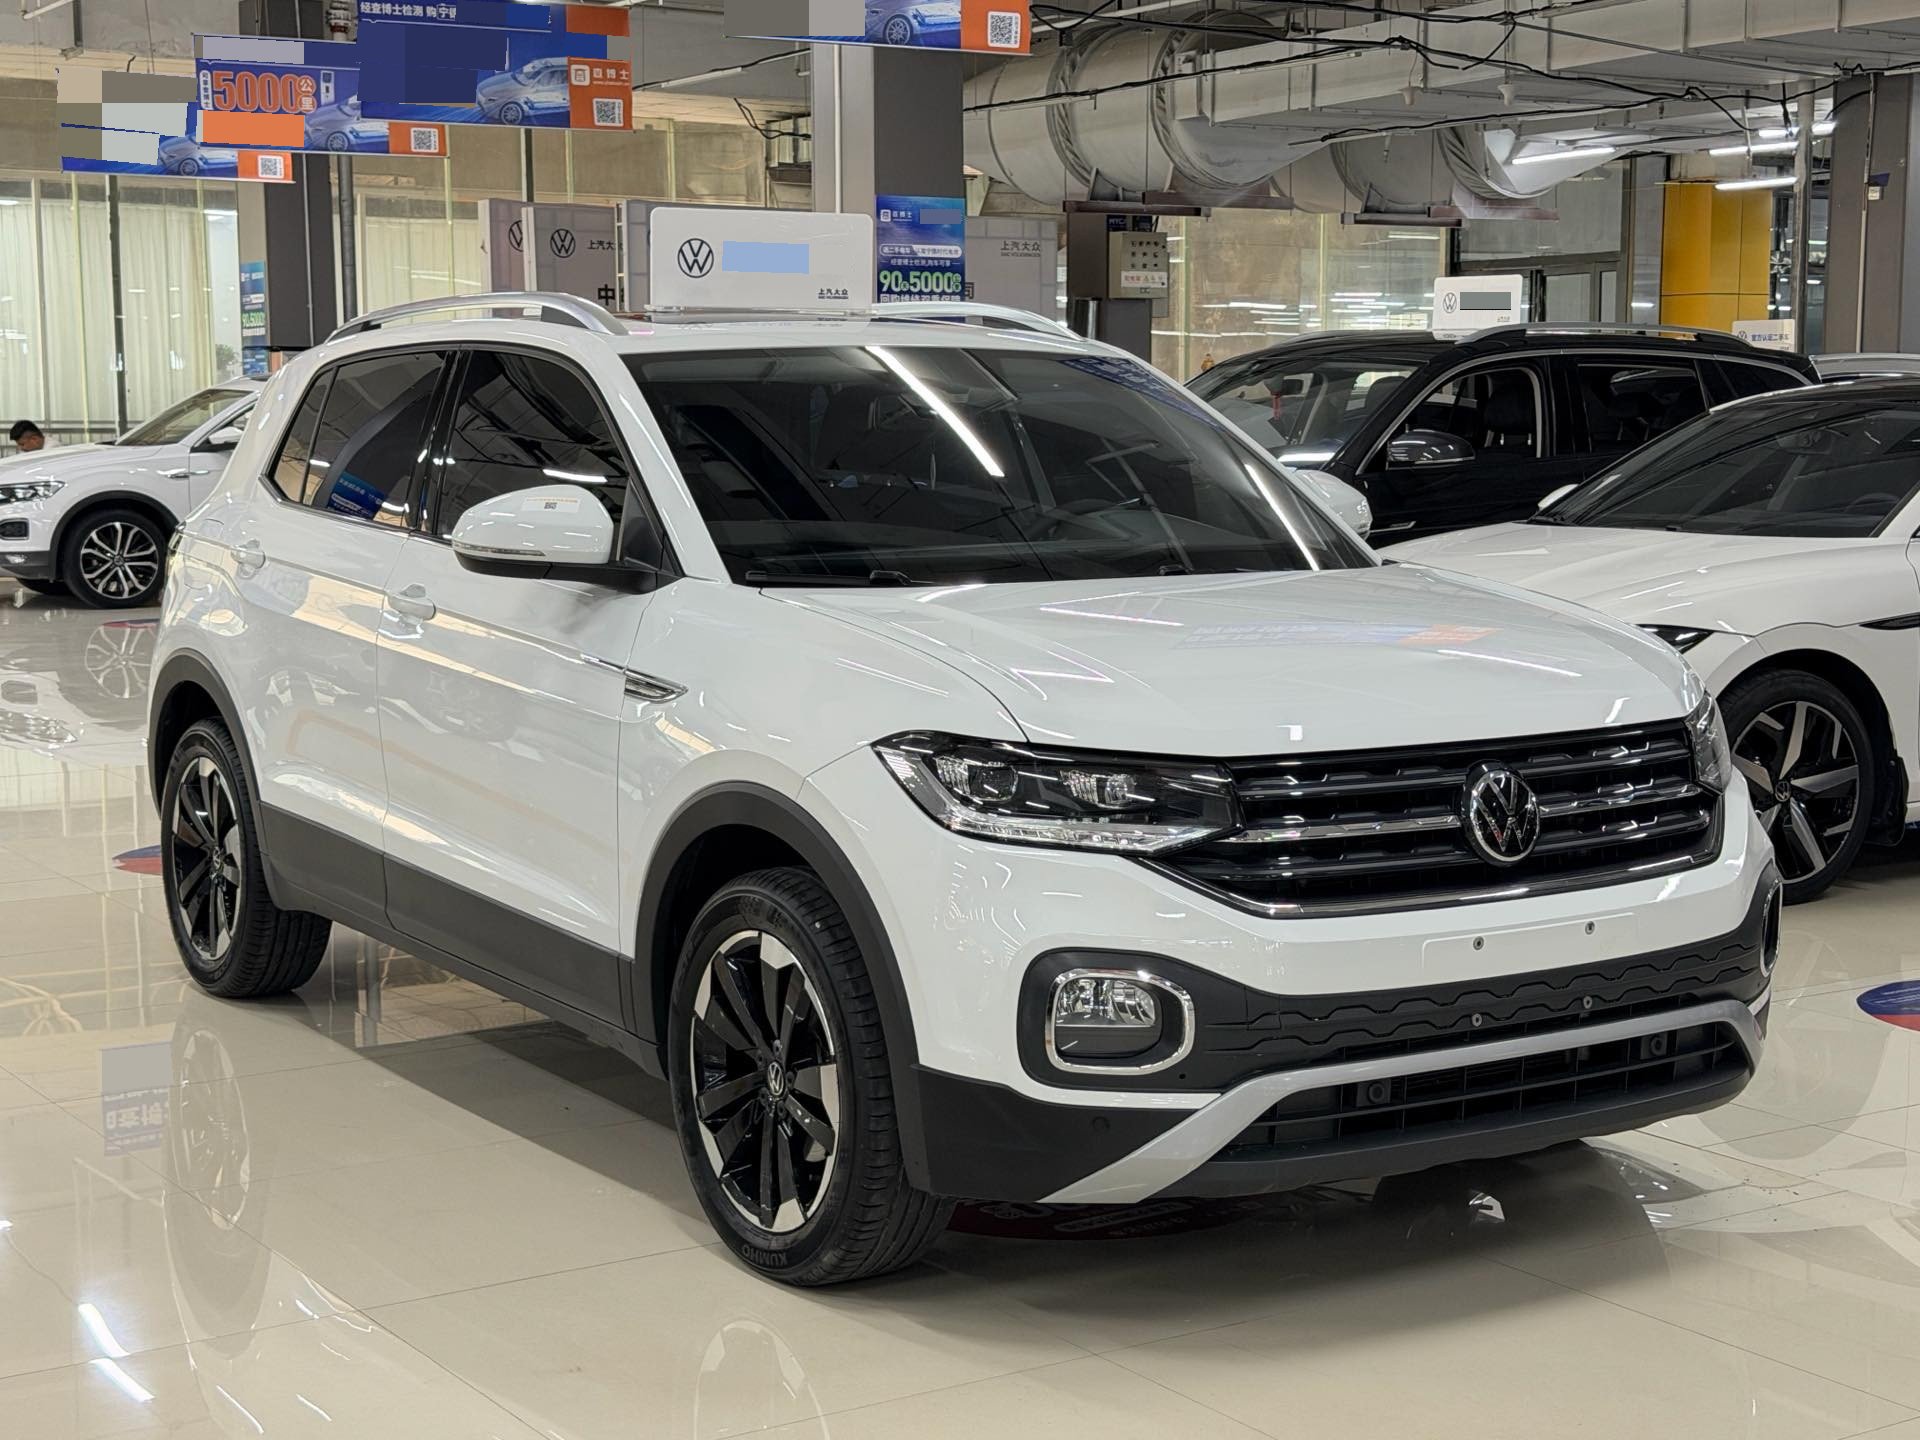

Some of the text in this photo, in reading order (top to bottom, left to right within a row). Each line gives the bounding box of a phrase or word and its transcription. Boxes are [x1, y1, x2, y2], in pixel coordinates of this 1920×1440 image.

[360, 2, 423, 17] 经查博士检测
[587, 239, 616, 251] 上汽大
[1000, 240, 1041, 252] 上汽大众
[818, 288, 849, 296] 上汽大众
[742, 1243, 788, 1267] KUMHO
